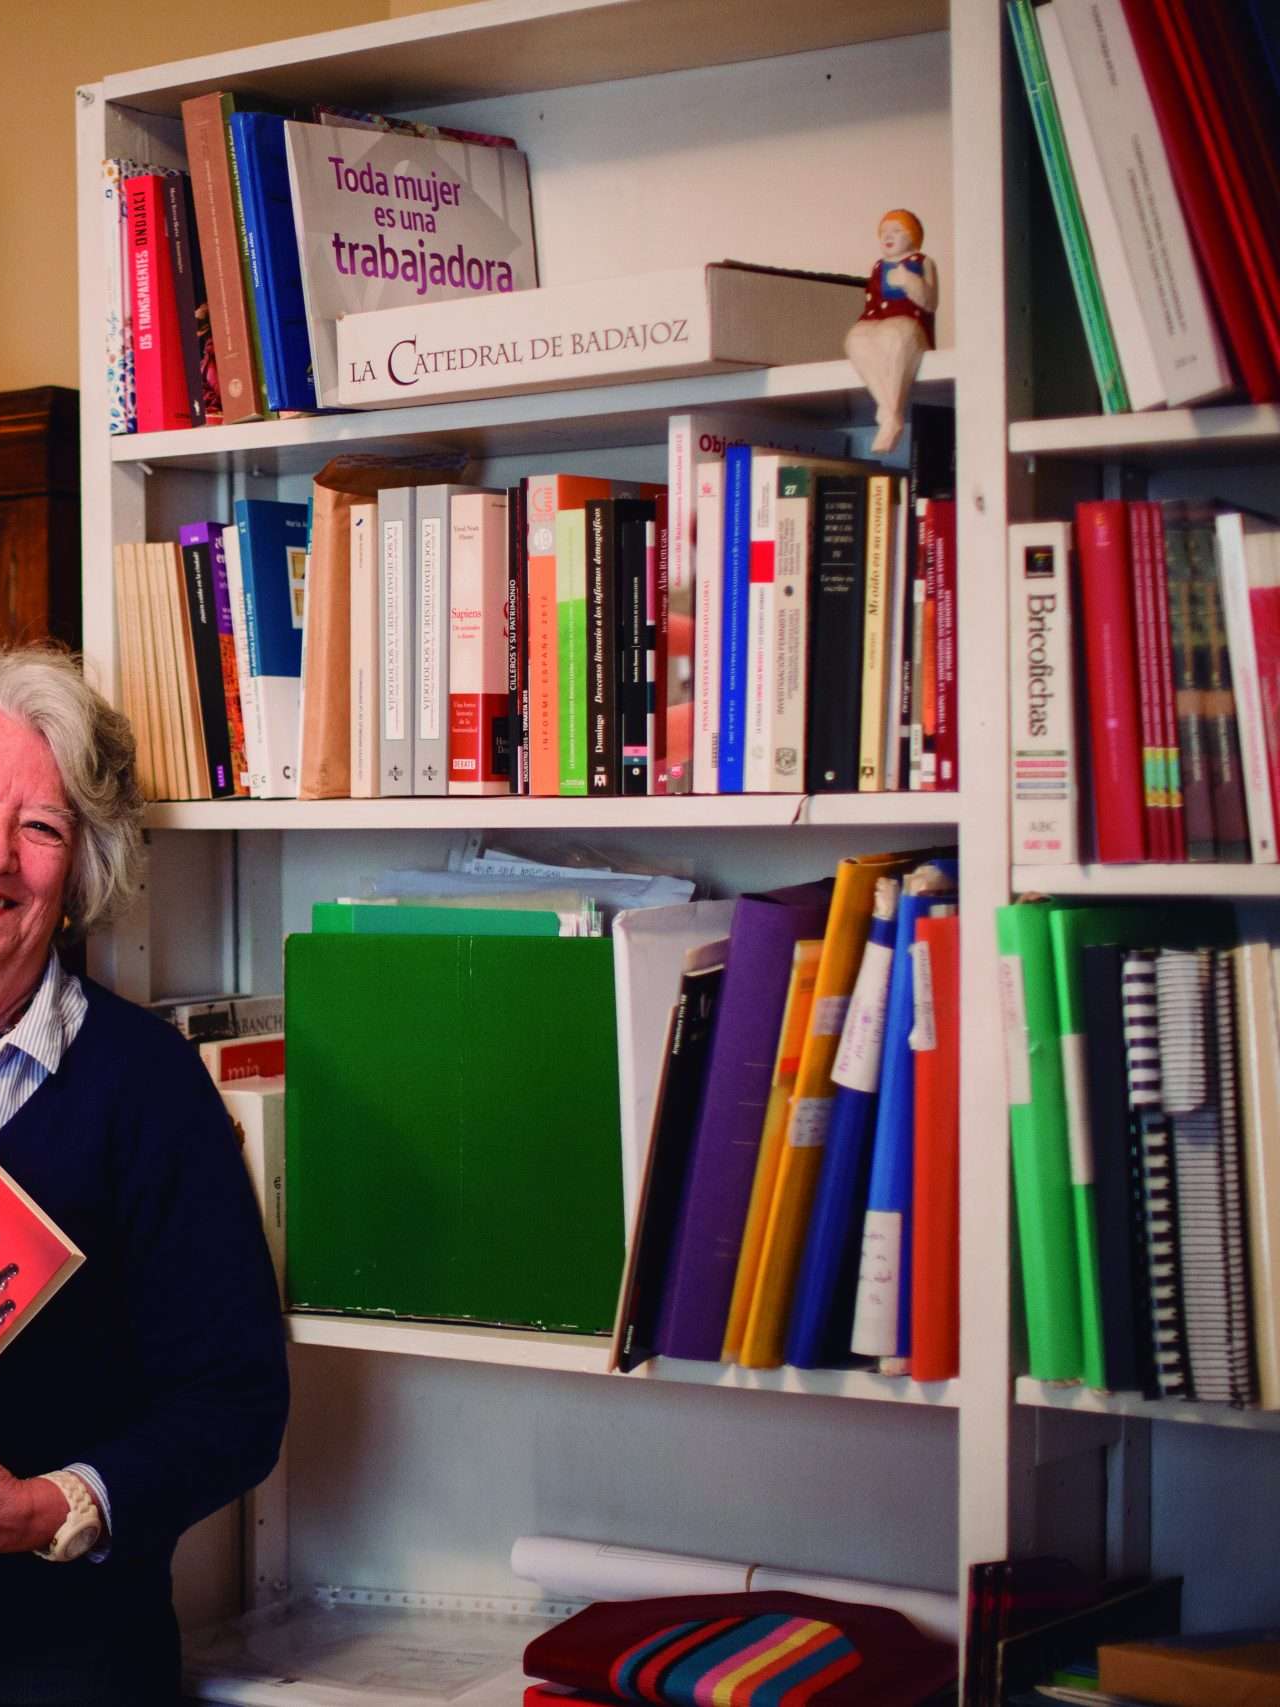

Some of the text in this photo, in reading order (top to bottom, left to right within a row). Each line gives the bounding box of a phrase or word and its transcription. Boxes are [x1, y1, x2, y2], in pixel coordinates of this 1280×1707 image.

[328, 156, 461, 212] Toda mujer
[374, 206, 436, 233] es una
[133, 191, 154, 350] OS TRANSPARENTES ONDJAKI
[332, 233, 513, 295] trabajadora
[350, 320, 689, 387] LA CATEDRAL DE BADAJOZ
[785, 484, 798, 495] 27
[872, 485, 883, 534] corazón
[387, 527, 395, 538] LA
[424, 524, 431, 536] LA
[592, 507, 603, 563] demográficos
[387, 541, 395, 595] SOCIEDAD
[872, 552, 880, 567] en
[593, 567, 603, 604] infiernos
[451, 607, 482, 623] Sapiens
[508, 579, 517, 631] PATRIMONIO
[593, 606, 602, 618] los
[868, 600, 879, 616] Mi
[387, 633, 395, 646] LA
[424, 631, 431, 645] LA
[509, 632, 517, 643] SU
[593, 628, 602, 662] literario
[509, 652, 517, 691] CILLEROS
[776, 609, 786, 715] INVESTIGACIÓN FEMINISTA
[1027, 594, 1057, 737] Bricofichas
[593, 664, 603, 703] Descenso
[594, 714, 605, 753] Domingo
